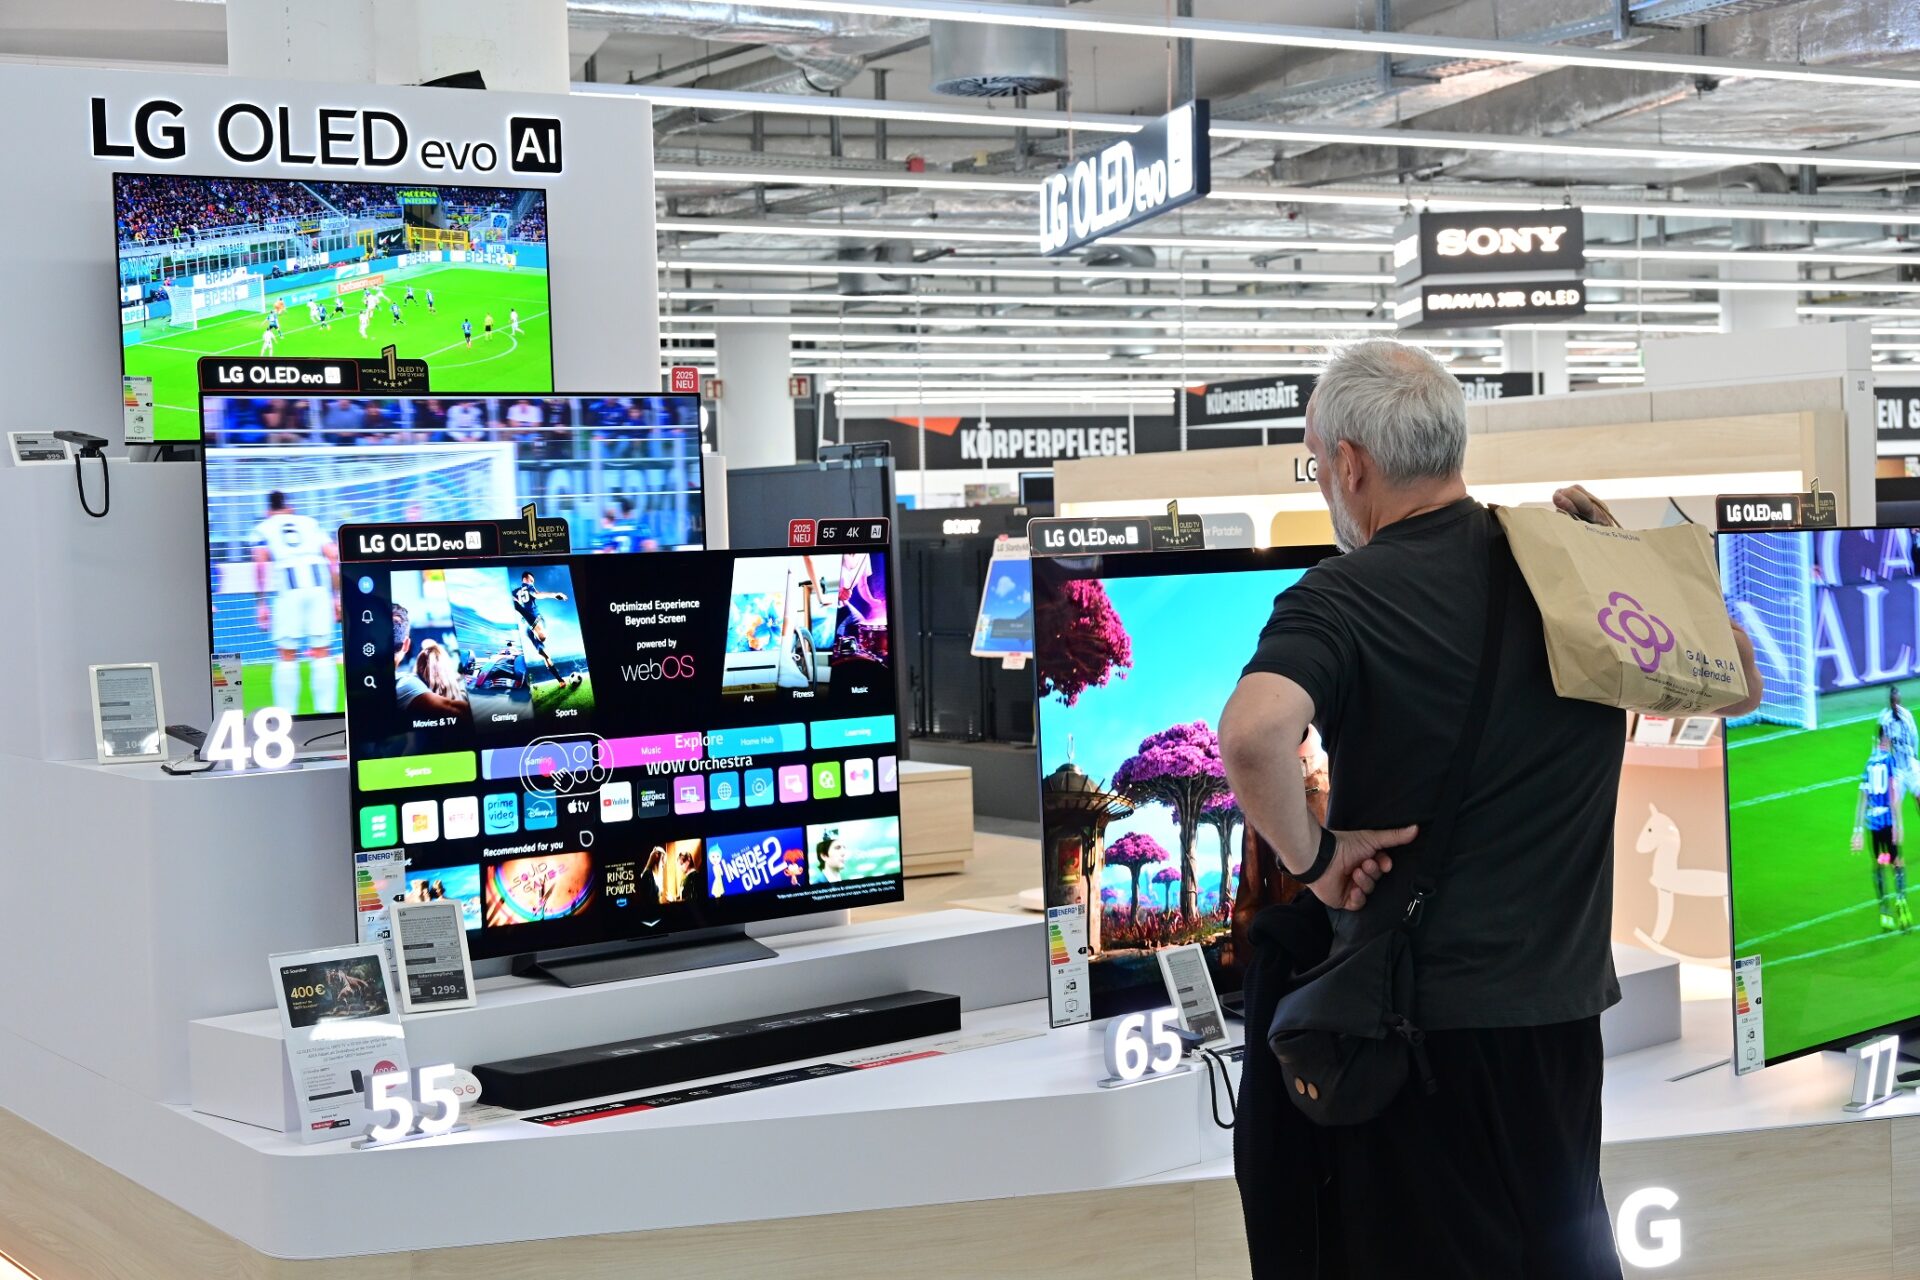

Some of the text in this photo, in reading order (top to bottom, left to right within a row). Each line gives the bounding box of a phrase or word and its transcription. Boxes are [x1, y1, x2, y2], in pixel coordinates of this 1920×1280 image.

[90, 97, 557, 171] LG OLED evo AI
[1040, 140, 1167, 253] LG OLED evo
[1436, 225, 1568, 256] SONY
[1427, 292, 1496, 311] BRAVIA
[1530, 289, 1580, 307] OLED
[218, 365, 324, 385] LG OLED evo
[675, 371, 694, 380] 2025
[675, 380, 694, 389] NEU
[1205, 380, 1300, 416] KÜCHENGERÄTE
[960, 422, 1129, 460] KÖRPERPFLEGE
[1726, 504, 1742, 522] LG
[1743, 503, 1771, 522] OLED
[537, 525, 555, 533] OLED
[793, 524, 811, 533] 2025
[846, 526, 860, 538] 4K
[359, 534, 385, 554] LG
[390, 532, 441, 553] OLED
[442, 538, 464, 551] evo
[793, 534, 811, 543] NEU
[1044, 527, 1125, 548] LG OLED evo
[610, 598, 700, 614] Optimized Experience
[625, 613, 687, 628] Beyond Screen
[636, 637, 677, 651] powered by
[620, 654, 695, 682] webOS
[793, 690, 815, 699] Fitness
[851, 686, 869, 694] Music
[743, 694, 755, 703] Art
[491, 713, 518, 724] Gaming
[555, 708, 578, 718] Sports
[412, 716, 457, 729] Movies & TV
[207, 706, 295, 772] 48
[674, 733, 724, 752] Explore
[740, 735, 774, 746] Home Hub
[641, 745, 662, 755] Music
[405, 766, 432, 777] Sports
[646, 753, 753, 776] WOW Orchestra
[487, 800, 514, 811] prime
[577, 800, 590, 813] tv
[641, 800, 656, 808] NOW
[488, 811, 515, 821] video
[483, 841, 564, 858] Recommended for you
[763, 836, 789, 877] 2
[721, 844, 768, 884] INSIDE
[606, 869, 635, 883] RINGS
[741, 860, 770, 891] OUT
[606, 882, 637, 897] POWER
[290, 983, 327, 999] 400 €
[431, 984, 464, 996] 1299.-
[1115, 1007, 1183, 1081] 65
[1860, 1034, 1900, 1105] 77
[371, 1063, 461, 1142] 55
